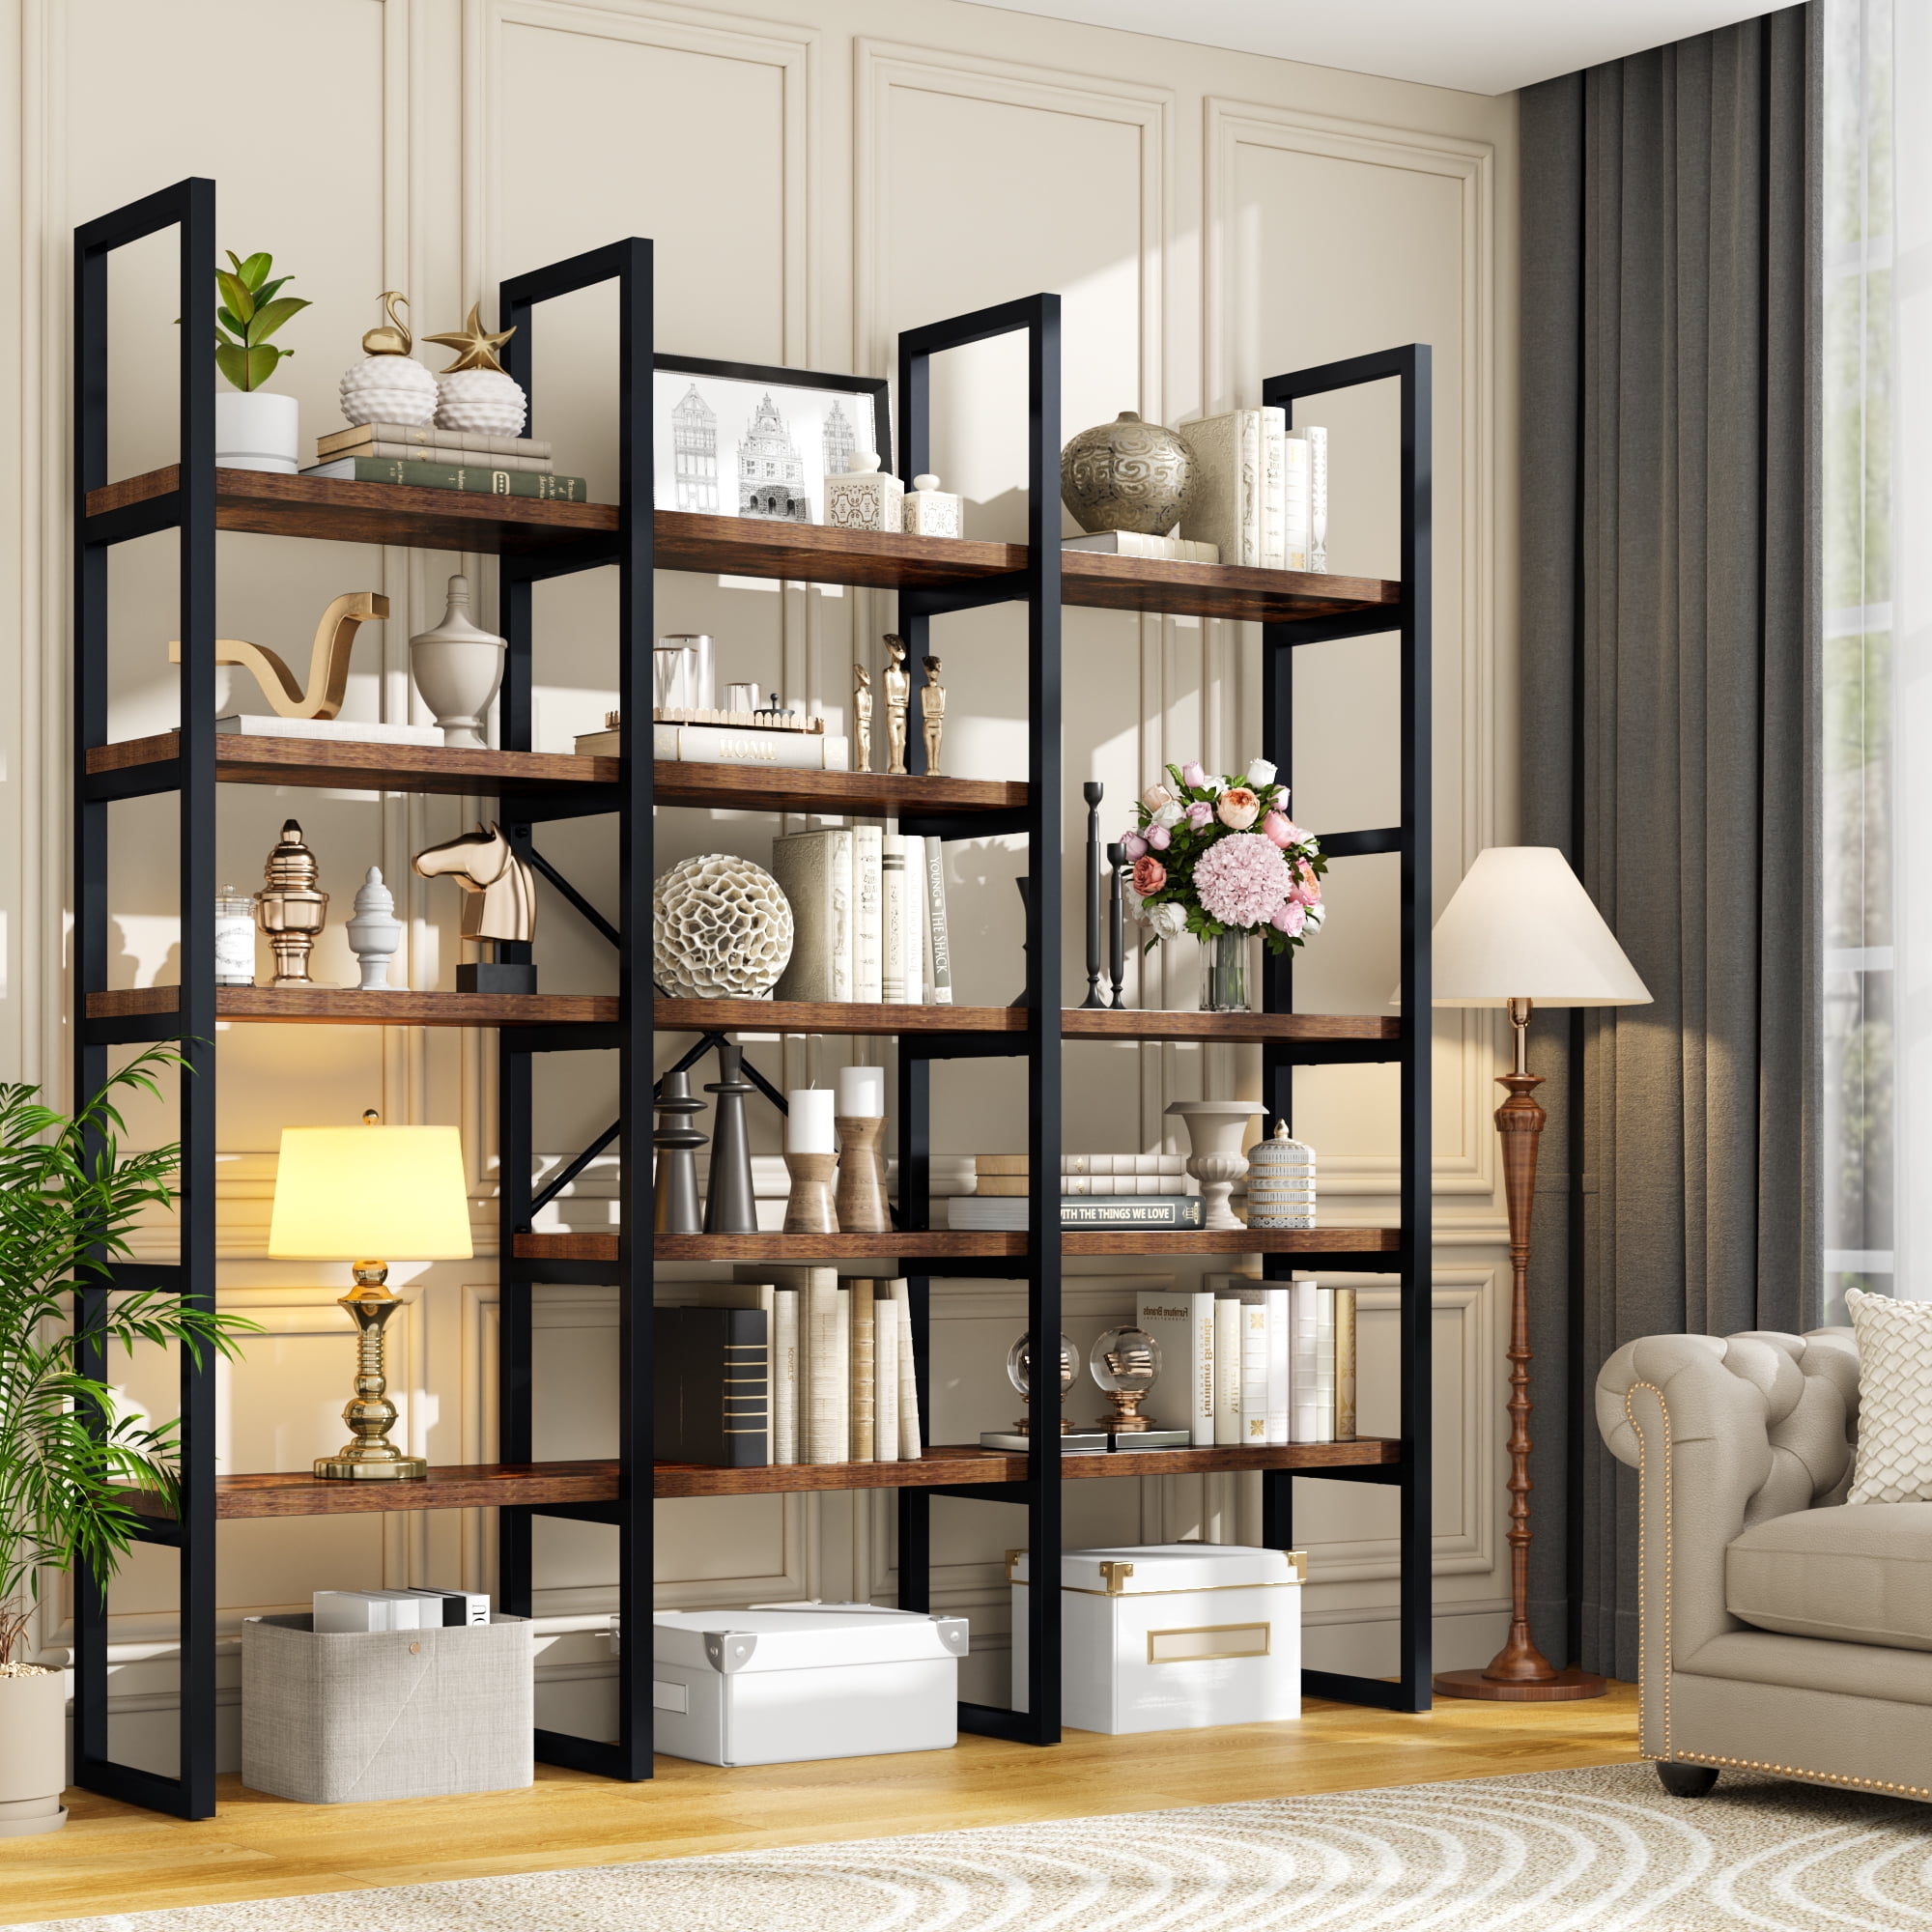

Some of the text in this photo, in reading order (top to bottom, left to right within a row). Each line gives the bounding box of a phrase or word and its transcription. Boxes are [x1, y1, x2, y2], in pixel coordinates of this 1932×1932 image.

[719, 738, 779, 760] HOME
[929, 857, 948, 974] YOUNG THE SHACK
[1079, 1208, 1097, 1220] THE
[1097, 1208, 1131, 1220] THINGS
[1132, 1208, 1147, 1219] WE
[1148, 1208, 1170, 1219] LOVE
